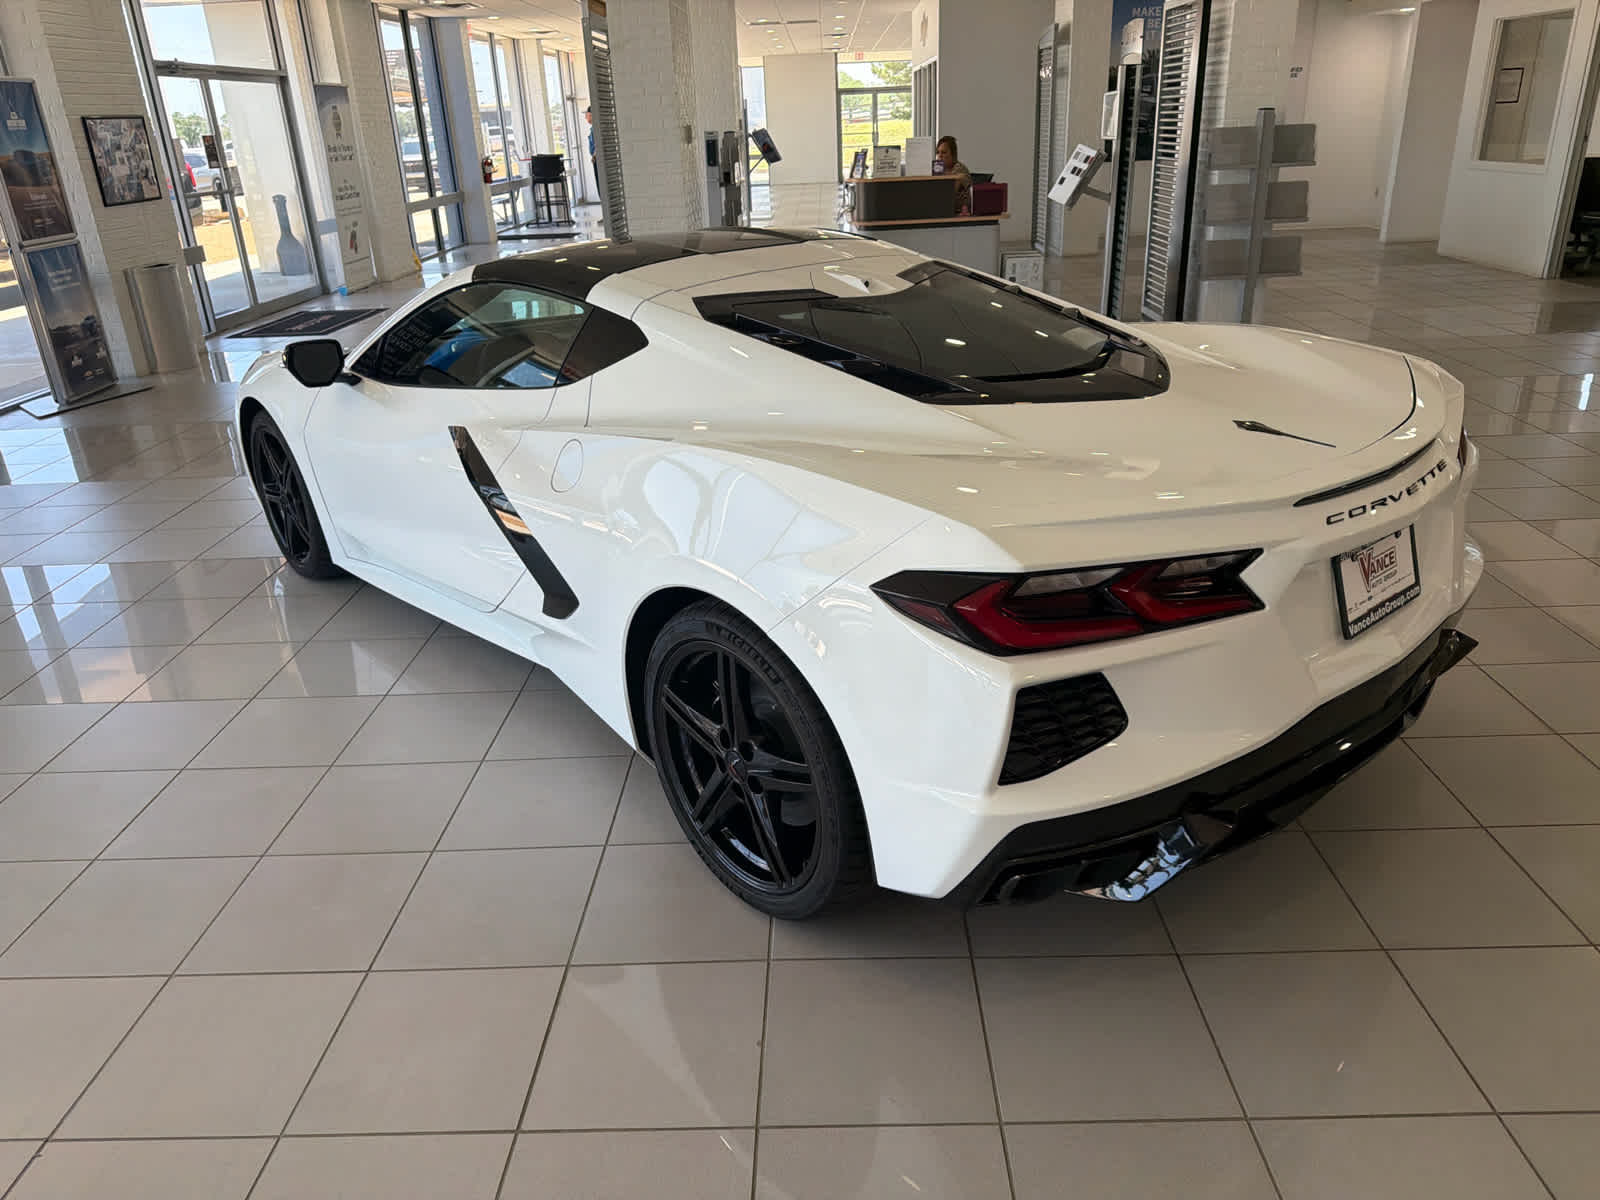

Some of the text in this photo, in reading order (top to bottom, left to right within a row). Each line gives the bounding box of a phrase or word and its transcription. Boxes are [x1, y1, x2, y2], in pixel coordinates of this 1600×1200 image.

[1132, 7, 1162, 17] MAKE
[1326, 458, 1448, 525] CORVETTE
[1349, 585, 1420, 636] VanceAutoGroup.com
